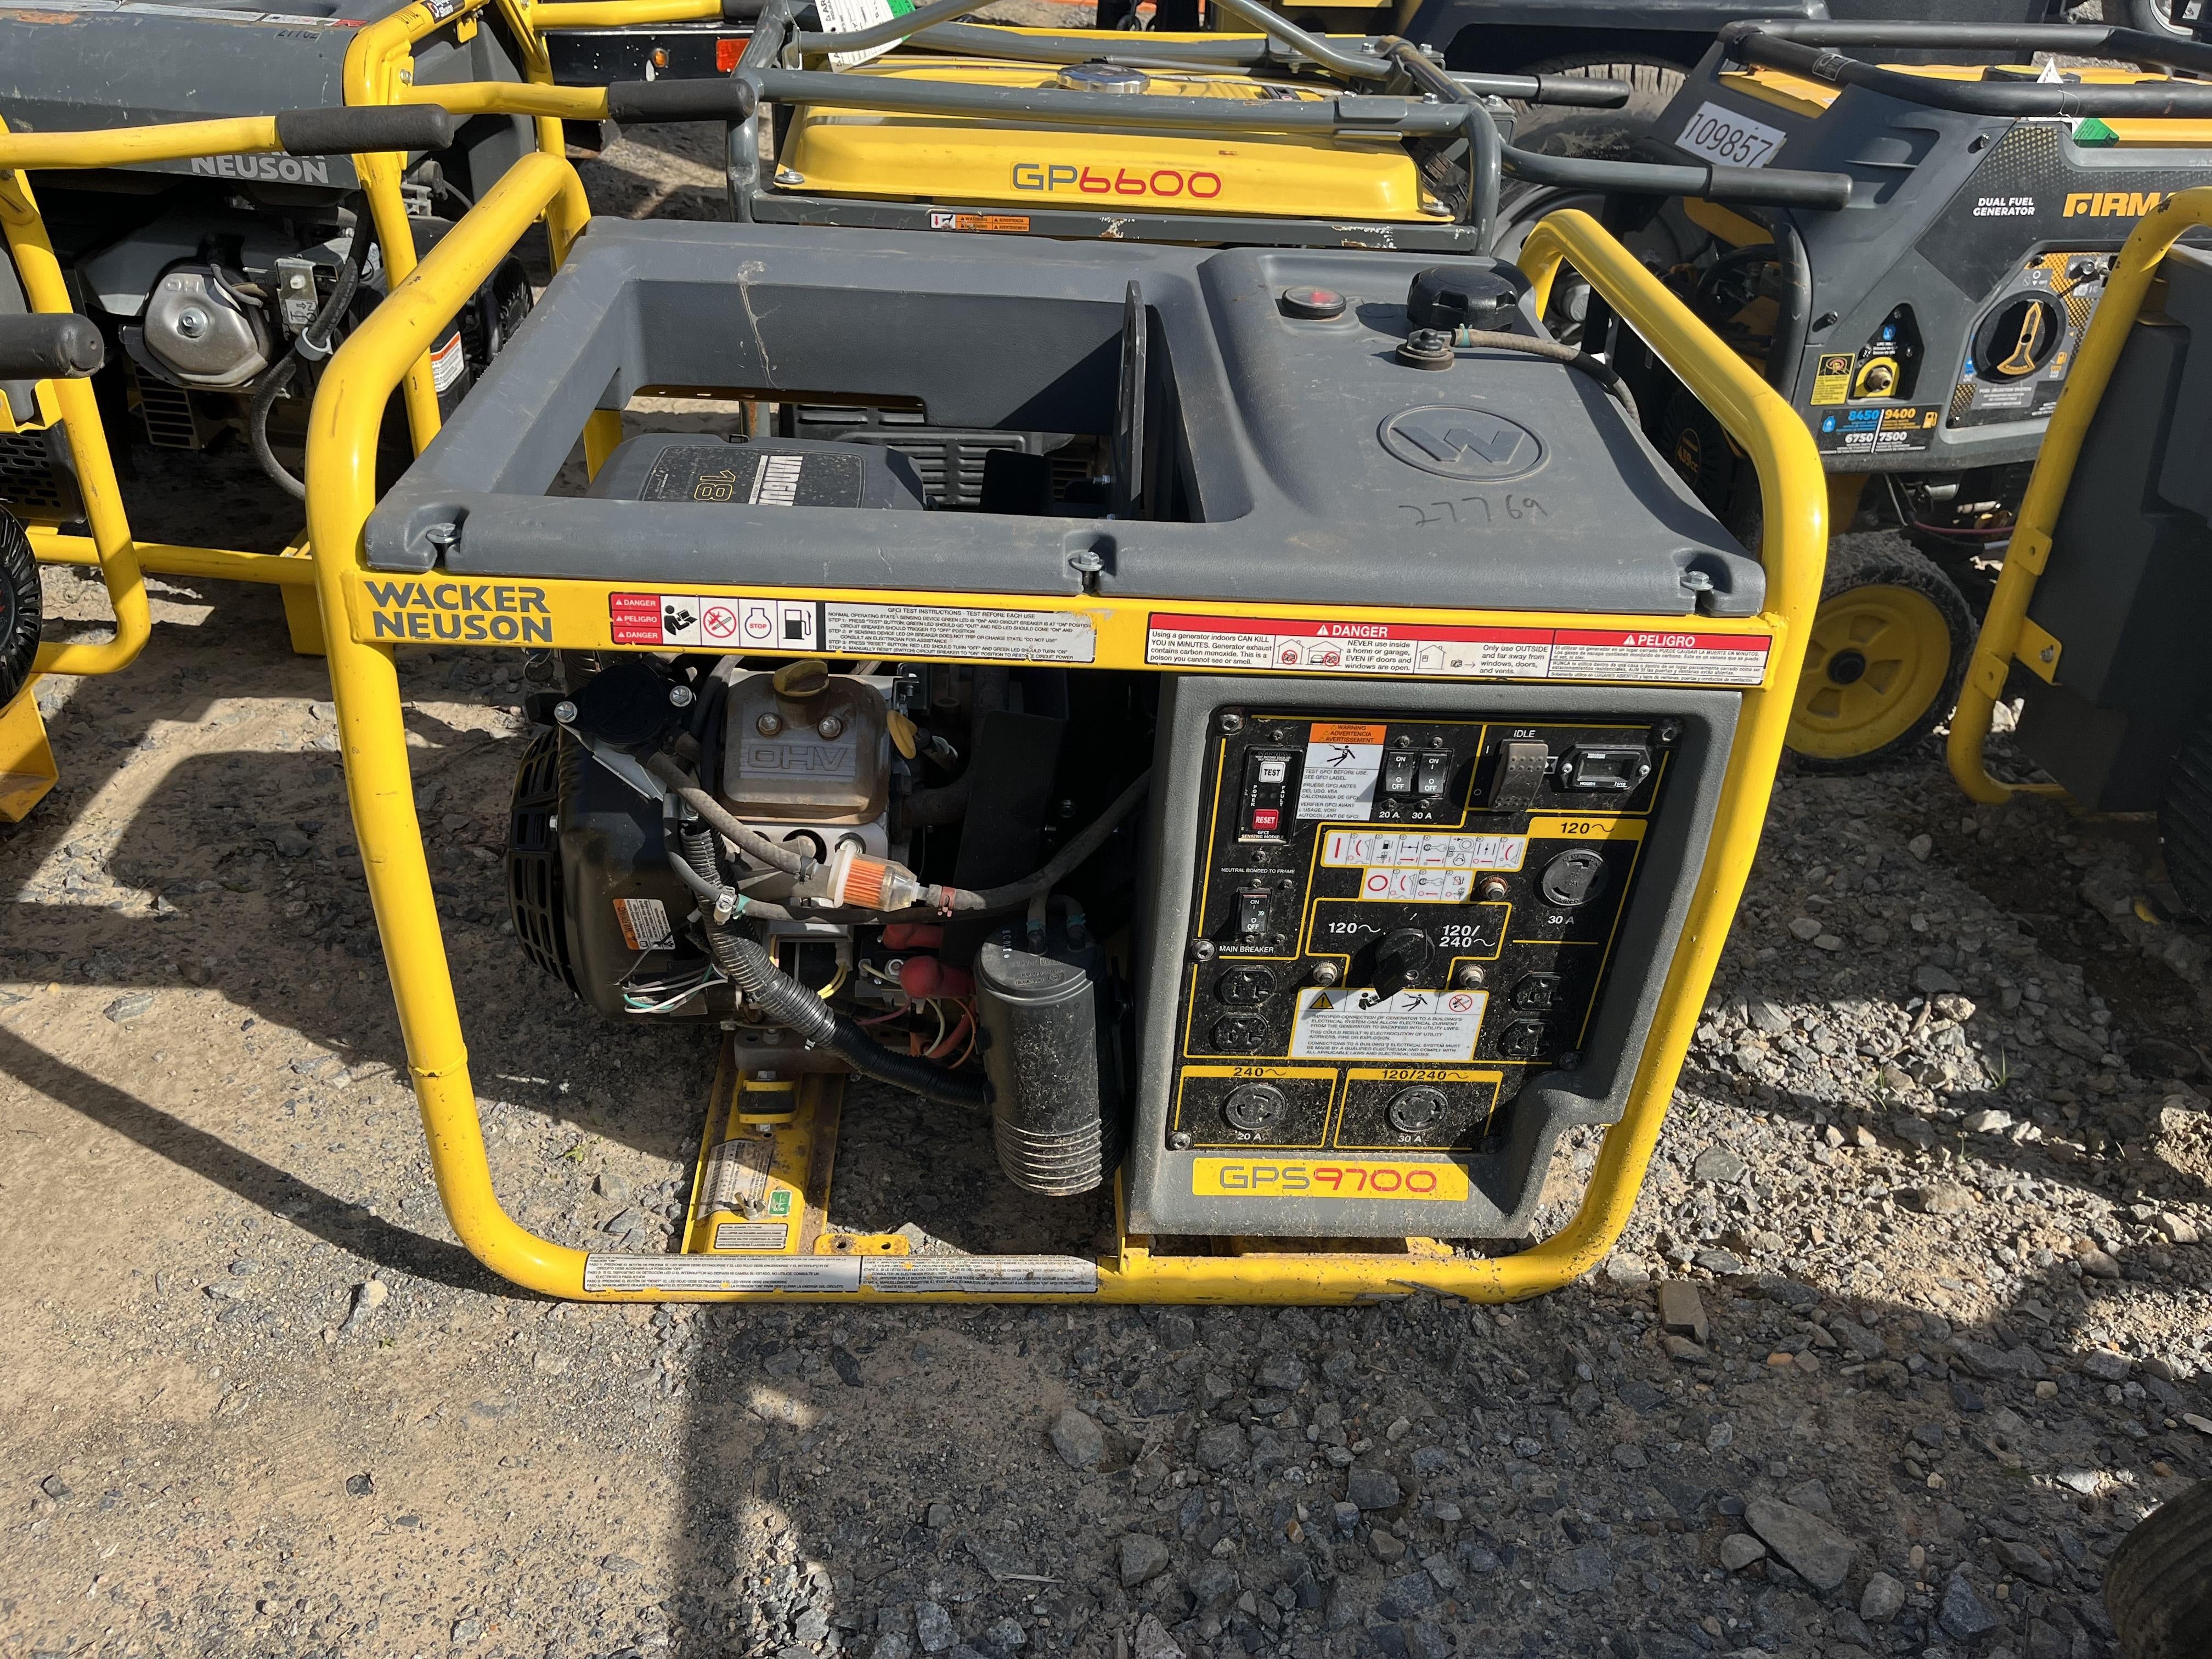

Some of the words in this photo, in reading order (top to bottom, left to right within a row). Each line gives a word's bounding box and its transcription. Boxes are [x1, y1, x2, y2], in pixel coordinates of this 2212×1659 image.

[1685, 114, 1773, 167] 109857
[191, 156, 329, 184] NEUSON
[1013, 163, 1222, 199] GP6600
[1978, 198, 2006, 206] DUAL
[2008, 198, 2034, 206] FUEL
[2063, 192, 2176, 217] FIRM
[1973, 207, 2035, 216] GENERATOR
[1848, 410, 1880, 421] 8450
[1884, 408, 1916, 419] 9400
[1845, 433, 1874, 442] 6750
[1879, 432, 1907, 442] 7500
[694, 470, 736, 501] 18
[1398, 494, 1548, 526] 27769
[364, 581, 551, 613] WACKER
[374, 612, 553, 642] NEUSON
[1332, 625, 1388, 637] DANGER
[1638, 634, 1695, 647] PELIGRO
[1513, 730, 1536, 738] IDLE
[748, 744, 848, 771] OHV
[1561, 822, 1589, 834] 120
[1548, 915, 1564, 924] 30
[1565, 916, 1575, 924] A
[1328, 922, 1357, 934] 120
[1443, 925, 1481, 936] 120/
[1439, 937, 1473, 949] 240
[1233, 1066, 1264, 1077] 240
[1382, 1069, 1447, 1081] 120/240
[1237, 1132, 1252, 1142] 20
[1254, 1133, 1262, 1142] A
[1398, 1134, 1412, 1143] 30
[1413, 1135, 1422, 1143] A
[1219, 1165, 1438, 1193] GPS9700
